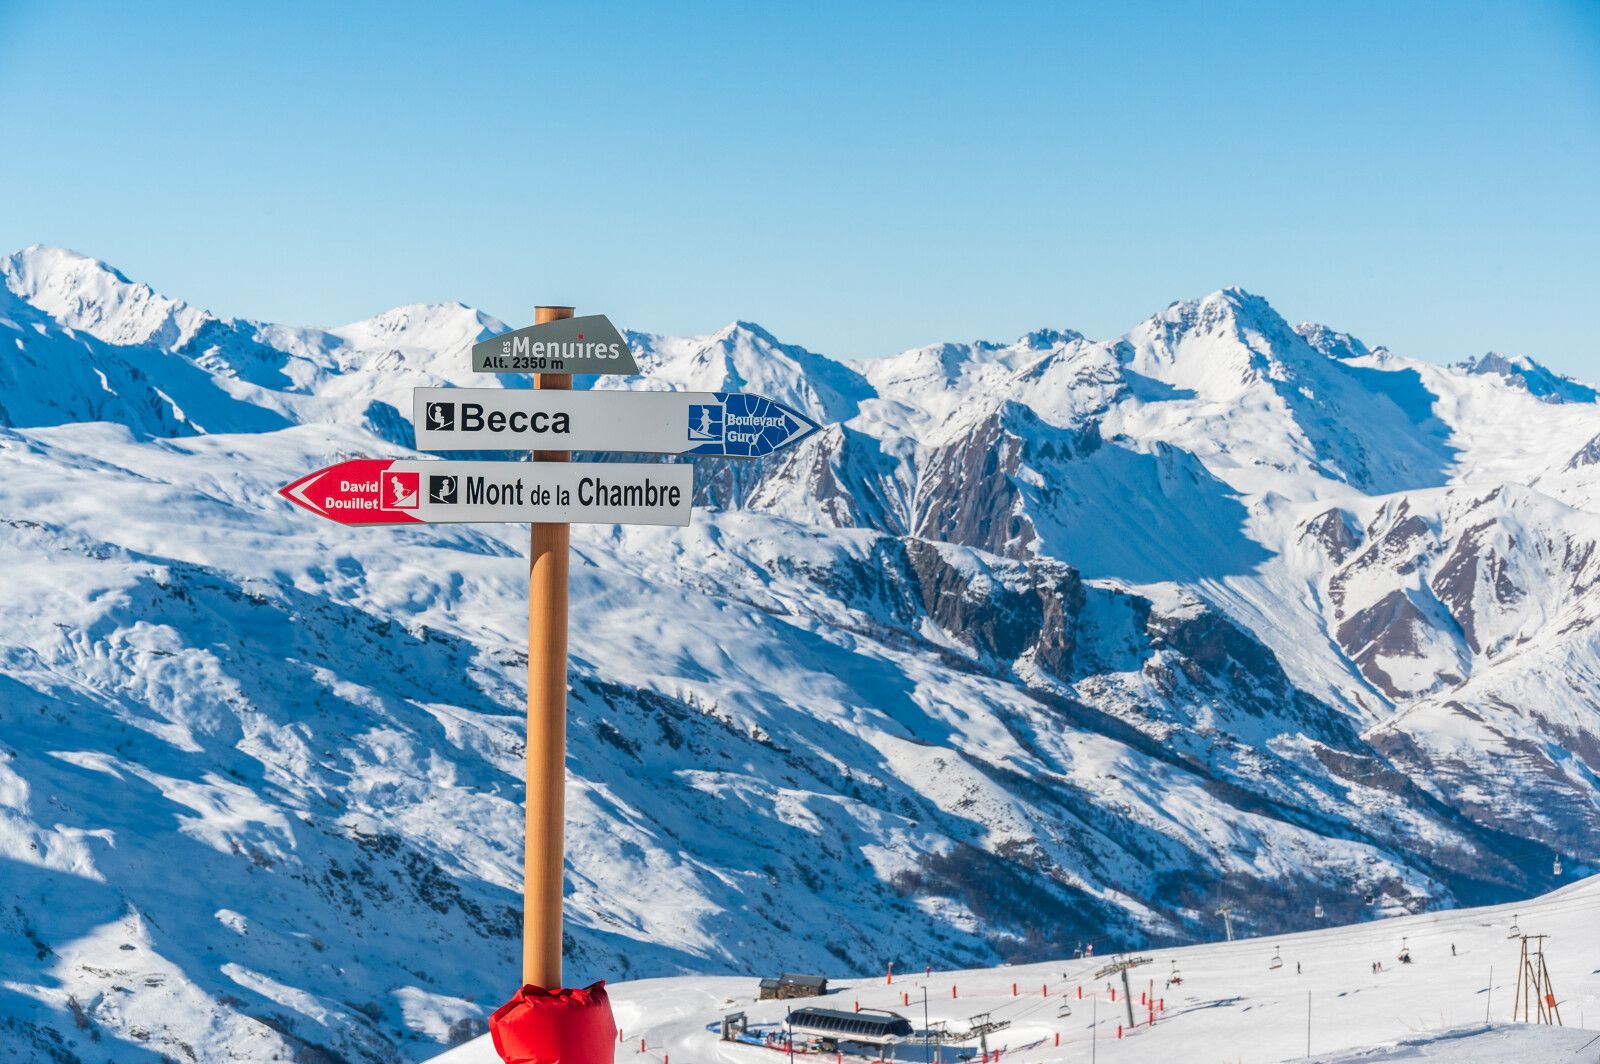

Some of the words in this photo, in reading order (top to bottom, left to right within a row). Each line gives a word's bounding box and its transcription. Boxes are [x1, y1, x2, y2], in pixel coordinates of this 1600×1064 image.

[500, 341, 511, 357] les
[513, 333, 620, 360] Menuires
[483, 357, 508, 369] Alt.
[512, 357, 547, 369] 2350
[551, 359, 564, 370] m
[461, 403, 571, 434] Becca
[727, 413, 786, 427] Boulevard
[727, 431, 761, 446] Gury
[340, 481, 379, 493] David
[466, 476, 523, 505] Mont
[530, 485, 551, 506] de
[556, 485, 570, 506] la
[578, 477, 681, 507] Chambre
[325, 497, 379, 510] Douillet
